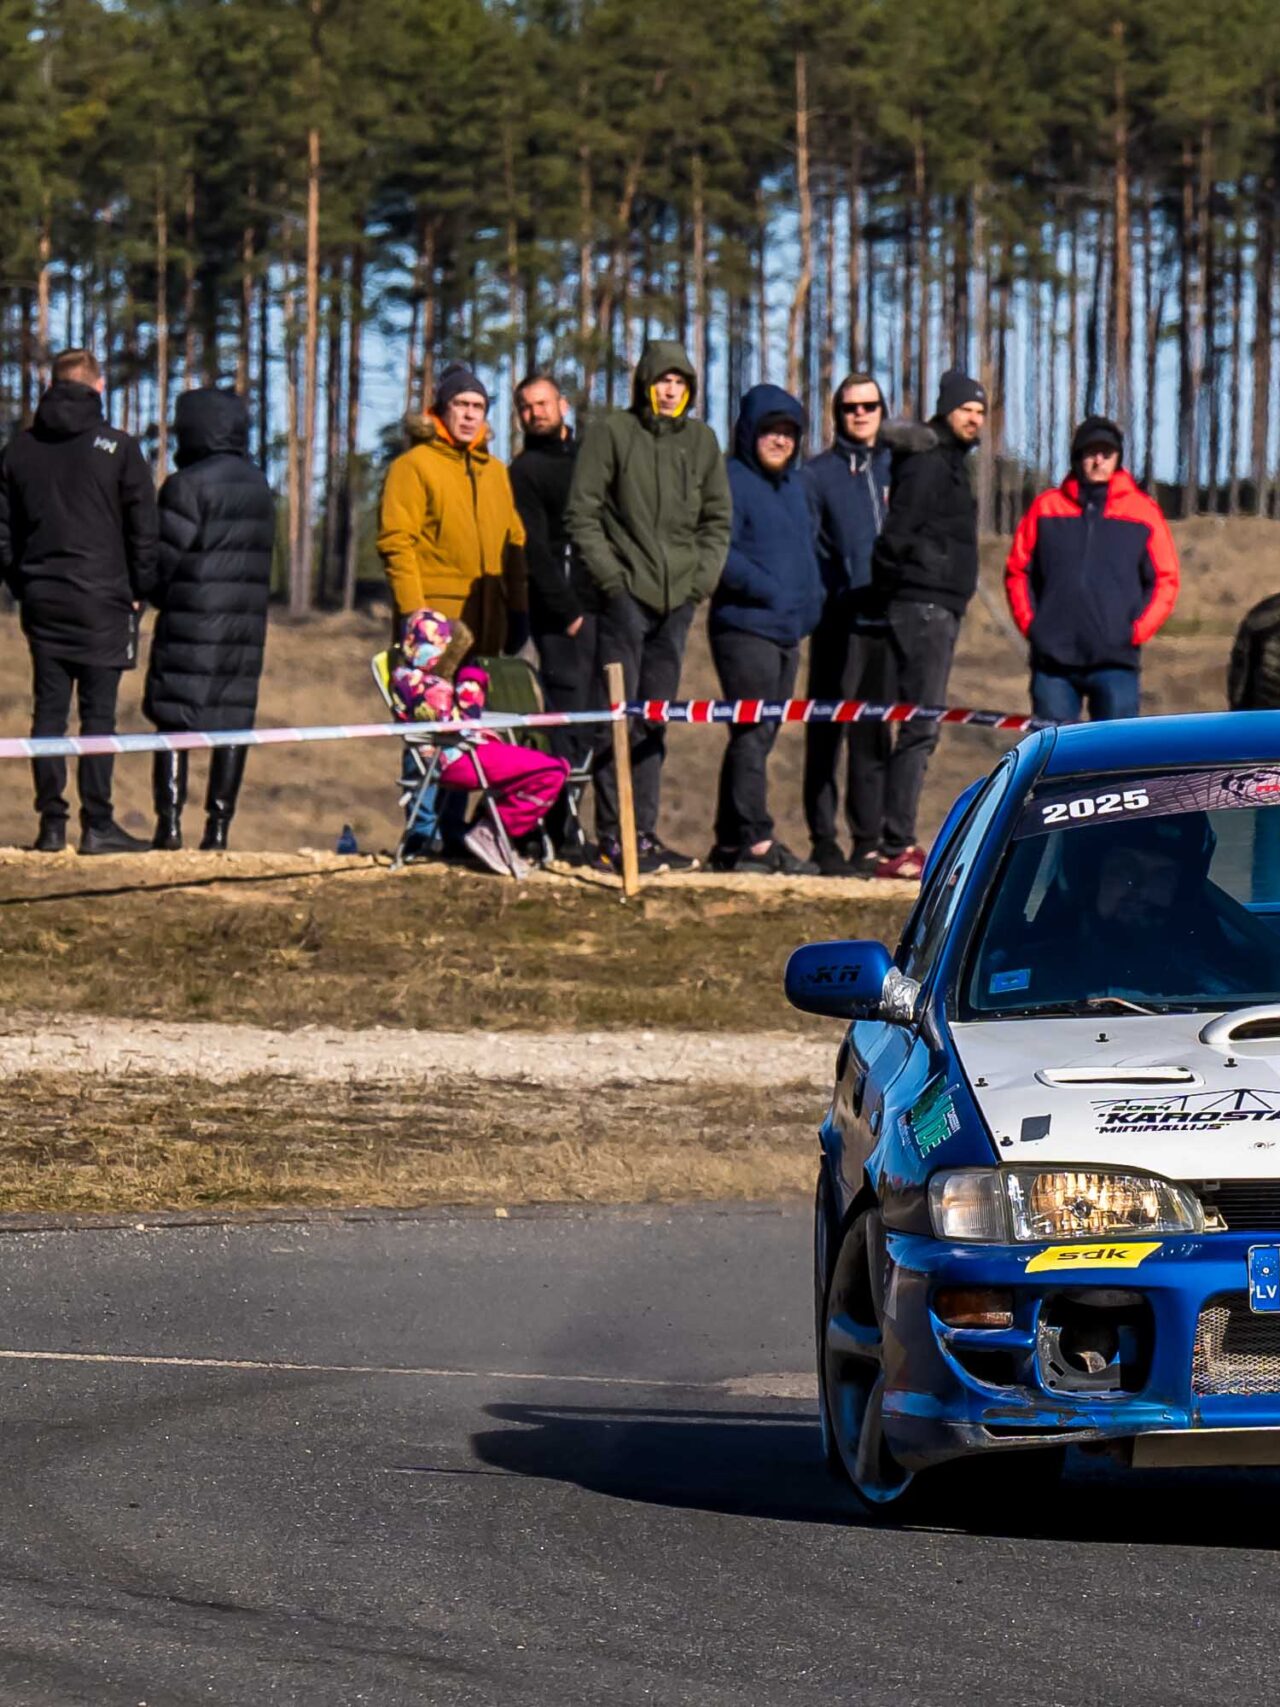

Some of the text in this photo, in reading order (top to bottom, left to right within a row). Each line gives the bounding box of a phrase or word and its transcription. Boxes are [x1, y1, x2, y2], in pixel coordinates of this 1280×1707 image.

[1042, 788, 1150, 825] 2025
[1057, 1248, 1130, 1261] sdk
[1256, 1285, 1277, 1299] LV
